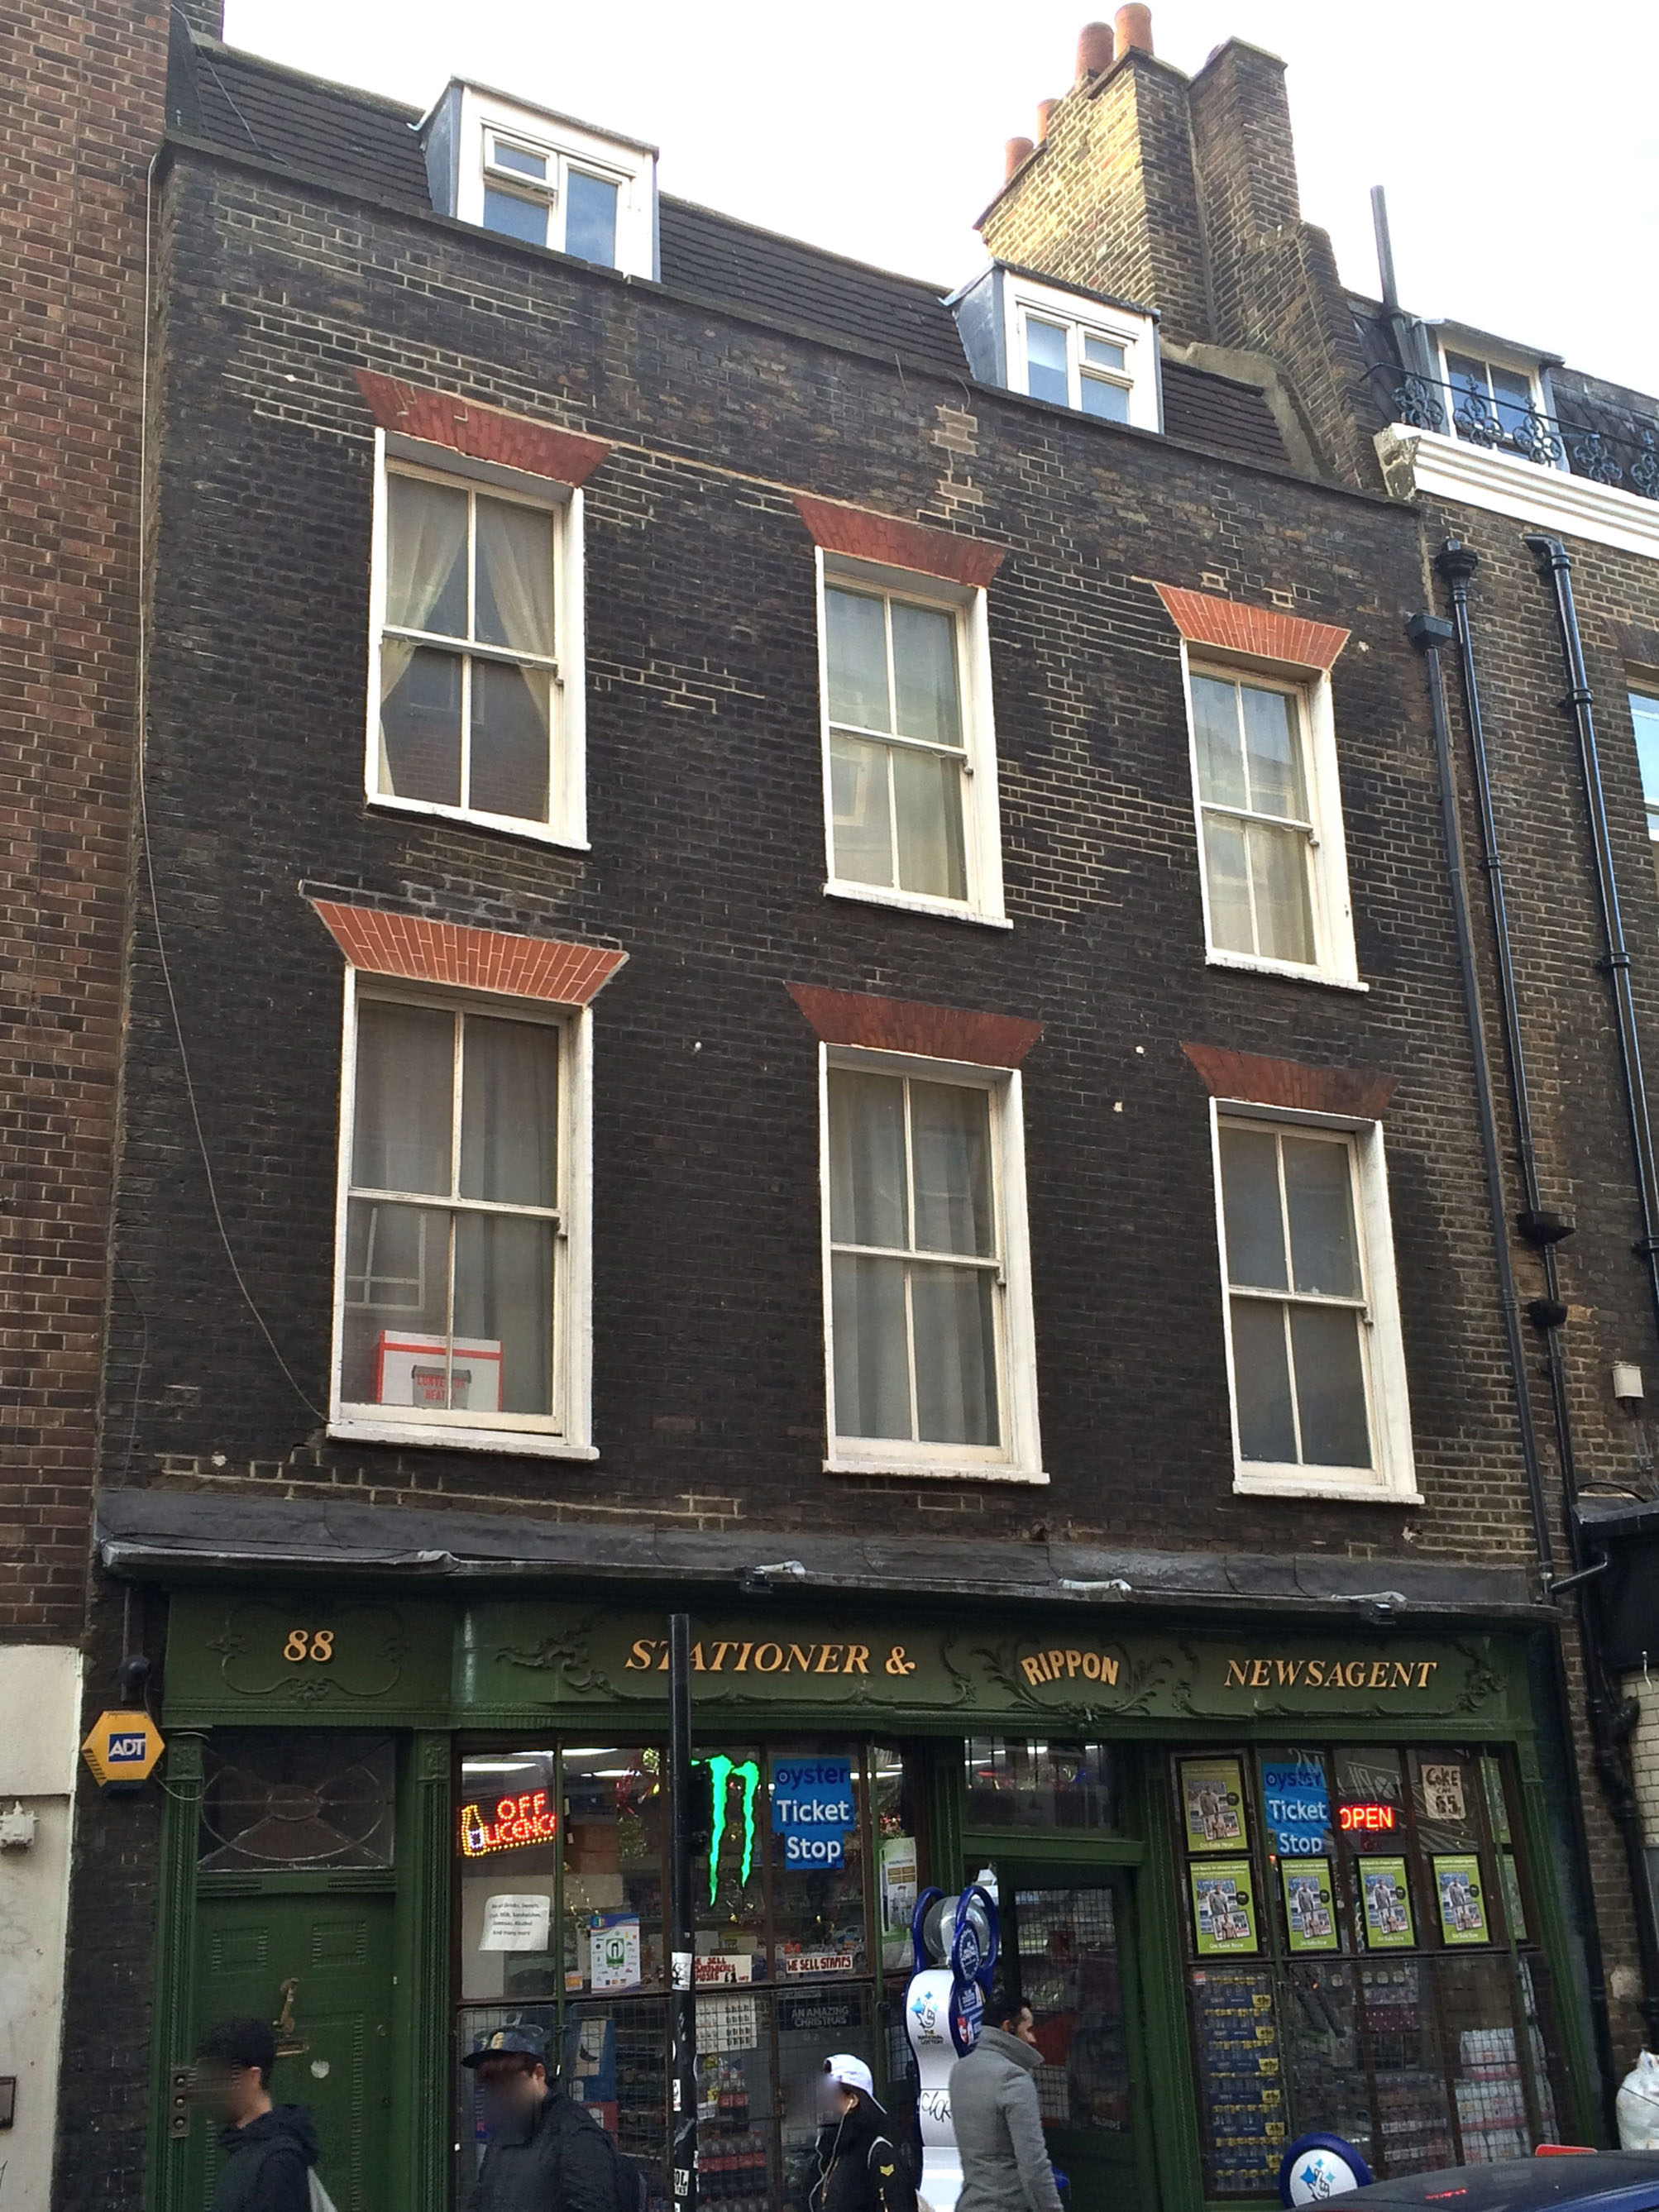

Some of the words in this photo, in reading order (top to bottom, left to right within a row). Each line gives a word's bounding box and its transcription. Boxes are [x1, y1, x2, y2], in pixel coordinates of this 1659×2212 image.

[416, 1374, 466, 1388] CONVEOR
[425, 1389, 457, 1401] HEATR
[284, 1630, 334, 1661] 88
[624, 1640, 870, 1675] STATIONER
[885, 1646, 916, 1675] &
[1021, 1650, 1119, 1686] RIPPON
[1224, 1659, 1437, 1688] NEWSAGENT
[108, 1738, 146, 1757] ADT
[777, 1763, 849, 1791] oyster
[1265, 1768, 1322, 1791] oyster
[497, 1792, 545, 1821] OFF
[777, 1799, 849, 1822] Ticket
[1269, 1799, 1327, 1820] Ticket
[1338, 1805, 1394, 1829] OPEN
[787, 1837, 841, 1863] Stop
[1279, 1832, 1322, 1854] Stop
[707, 1956, 726, 1965] SELL
[787, 1960, 797, 1971] WE
[800, 1958, 820, 1970] SELL
[820, 1956, 851, 1969] STAMPS
[791, 2008, 806, 2018] AN
[806, 2005, 849, 2019] AMAZING
[795, 2016, 848, 2028] CHRISTMAS
